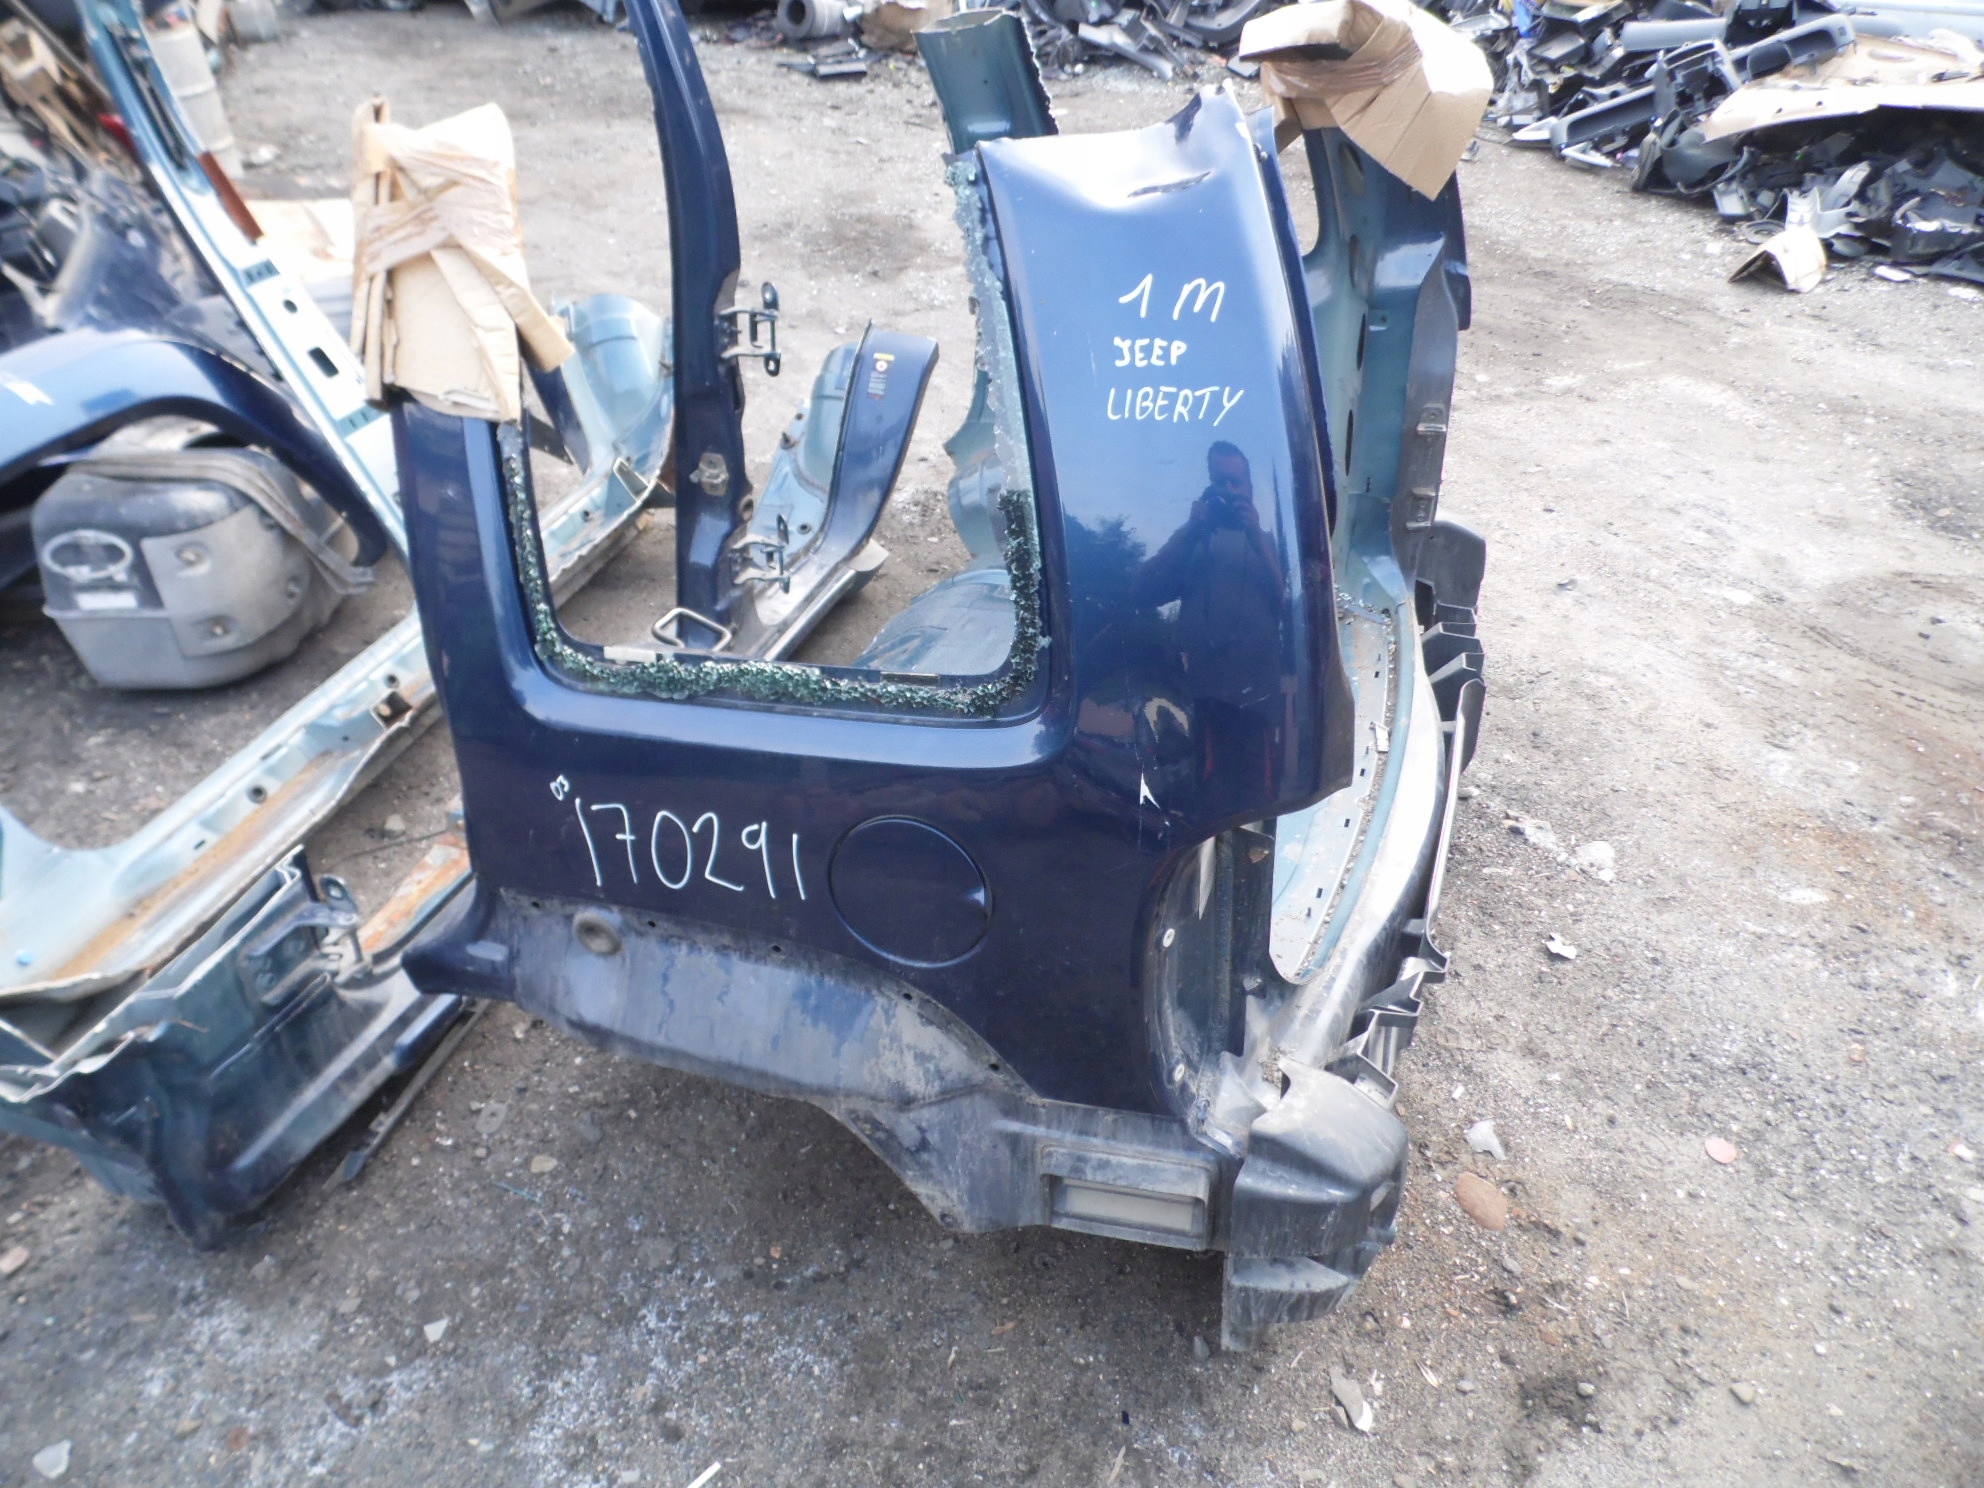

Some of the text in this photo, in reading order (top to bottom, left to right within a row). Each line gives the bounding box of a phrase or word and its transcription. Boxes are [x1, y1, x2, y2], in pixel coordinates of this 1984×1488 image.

[1117, 272, 1154, 319] 1
[1113, 336, 1188, 368] JEEP
[1106, 385, 1245, 427] LIBERTY
[574, 797, 806, 901] 170291
